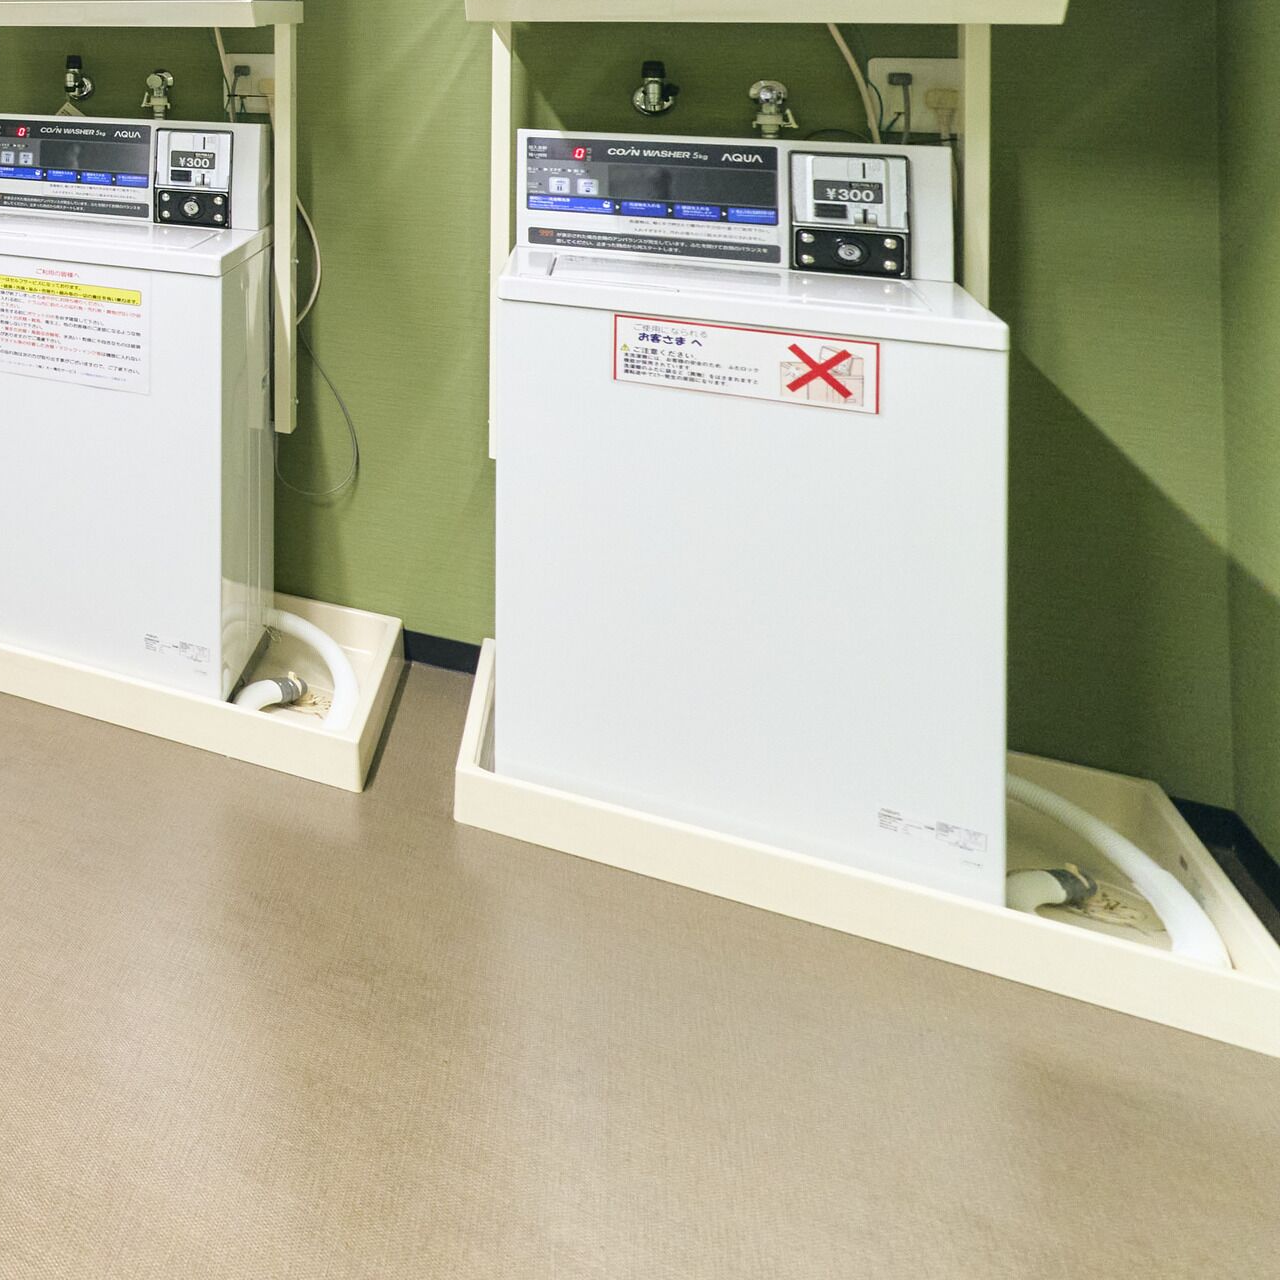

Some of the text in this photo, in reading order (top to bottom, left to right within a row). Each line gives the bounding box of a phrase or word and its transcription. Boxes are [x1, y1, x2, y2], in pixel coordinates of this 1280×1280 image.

[17, 127, 26, 137] 0
[40, 125, 62, 134] COIN
[63, 128, 95, 136] WASHER
[114, 130, 141, 139] AQUA
[574, 148, 585, 159] 0
[607, 146, 641, 158] COIN
[643, 149, 691, 159] WASHER
[179, 157, 210, 168] ¥300
[722, 153, 763, 164] AQUA
[826, 187, 874, 202] ¥300
[633, 323, 708, 338] ご使用になられる
